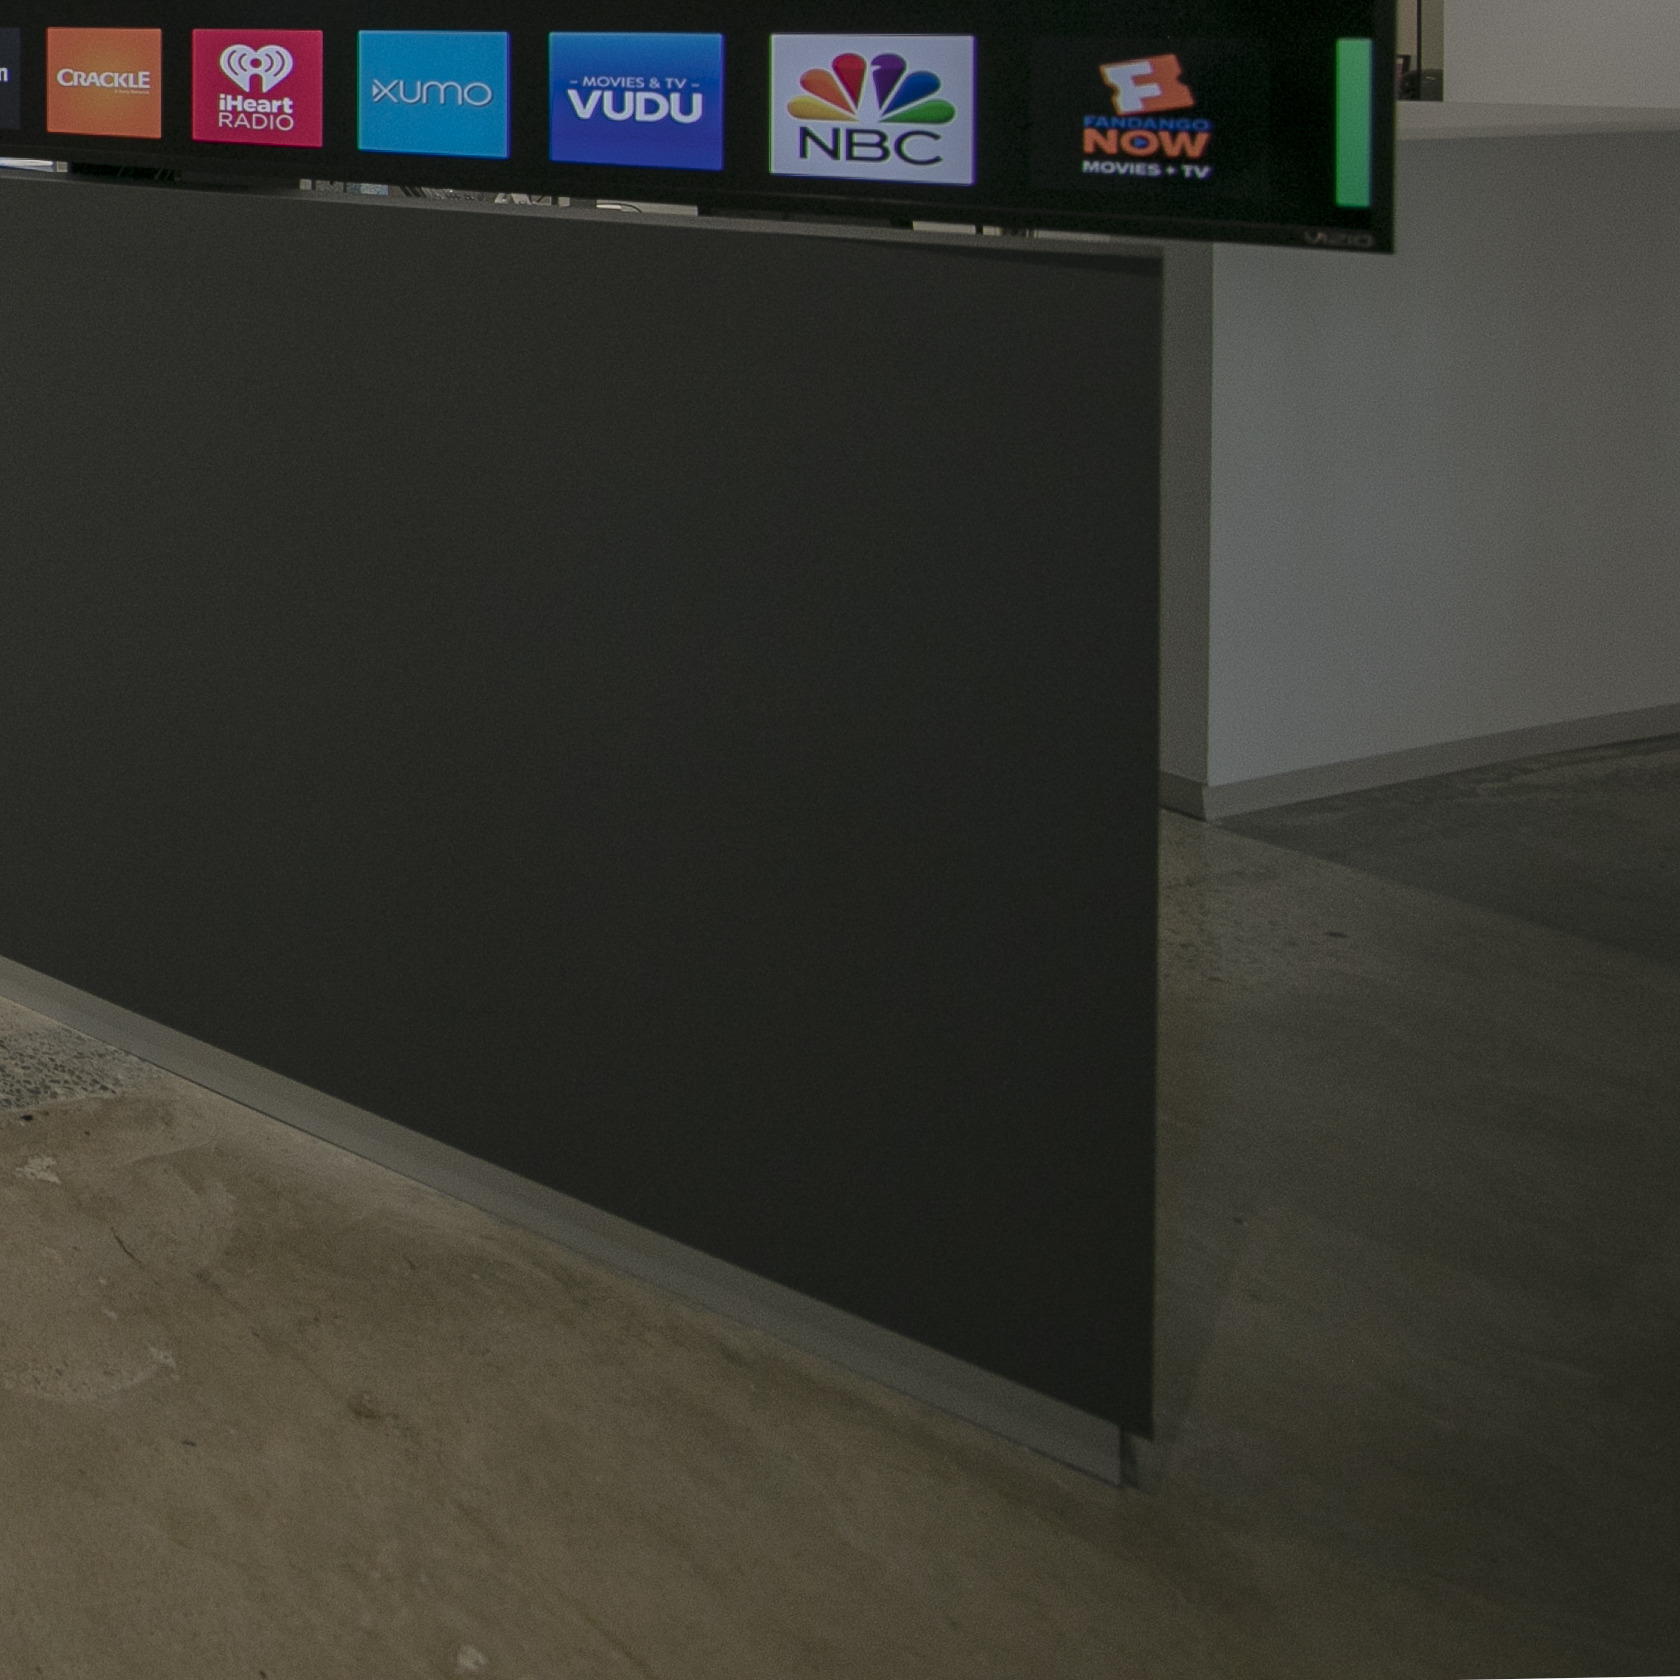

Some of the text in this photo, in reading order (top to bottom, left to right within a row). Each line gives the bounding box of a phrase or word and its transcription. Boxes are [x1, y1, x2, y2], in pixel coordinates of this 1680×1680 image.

[56, 68, 151, 89] CRACKLE
[582, 76, 687, 90] MOVIES & TV
[218, 93, 294, 114] iHeart
[567, 89, 703, 125] VUDU
[217, 112, 295, 131] RADIO
[1083, 115, 1212, 132] FANDANGO
[798, 126, 945, 167] NBC
[1082, 127, 1211, 159] NOW
[1082, 161, 1162, 177] MOVIES
[1181, 165, 1211, 179] TV
